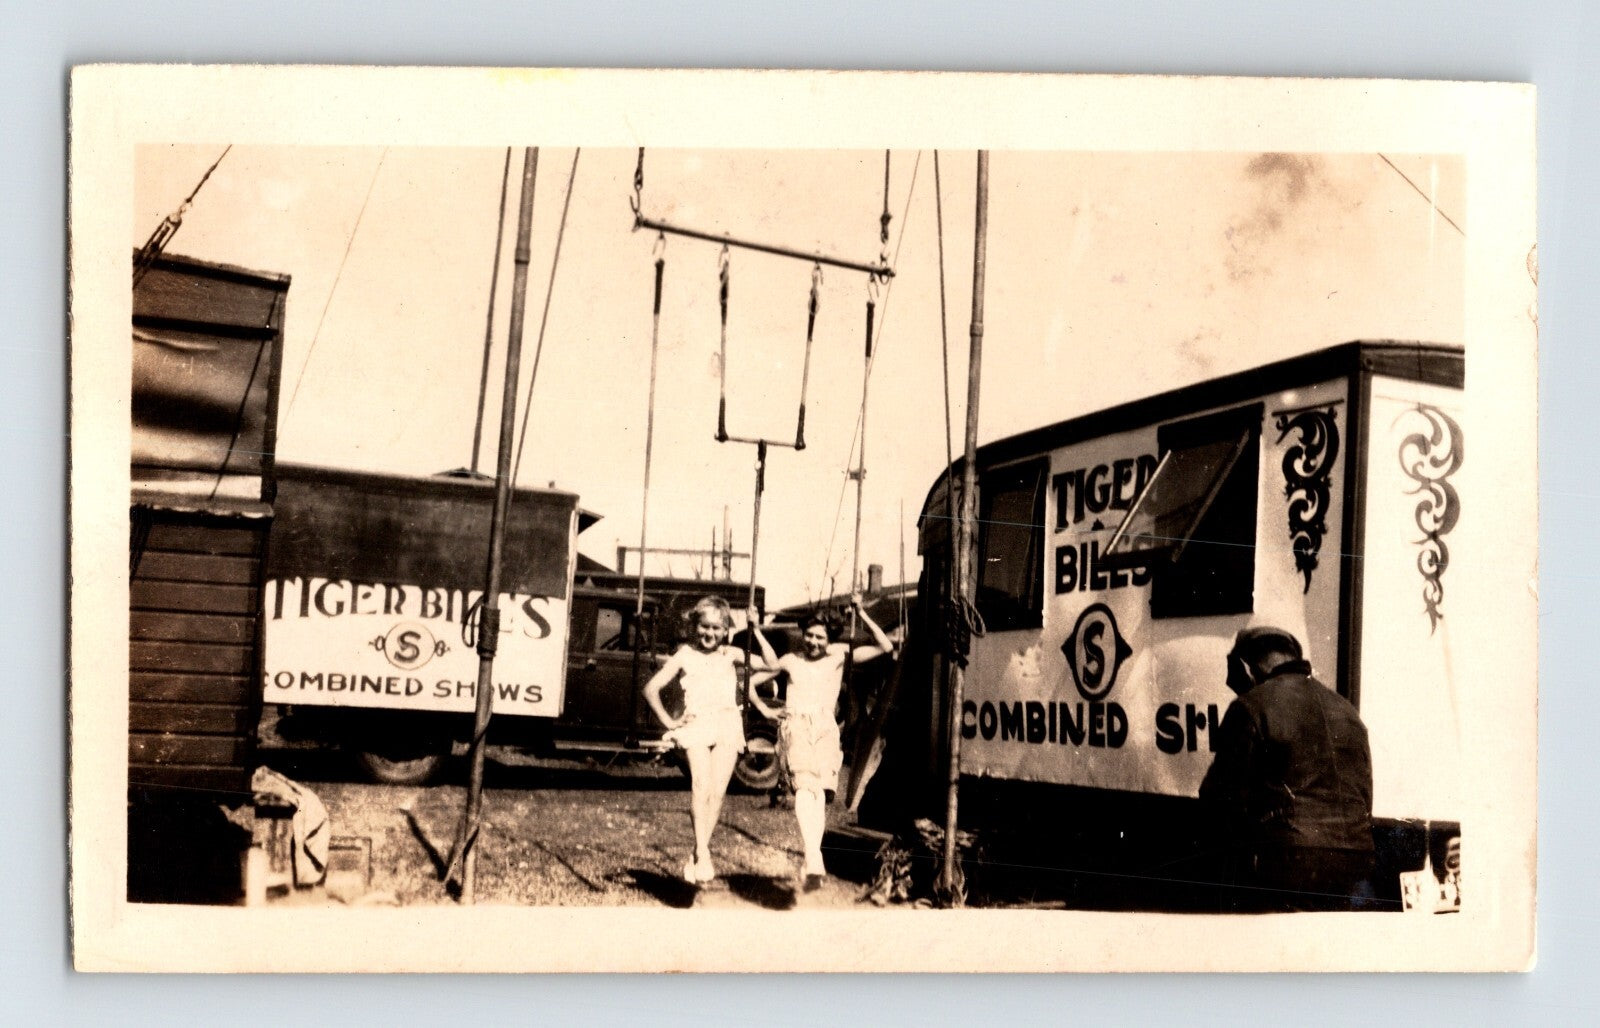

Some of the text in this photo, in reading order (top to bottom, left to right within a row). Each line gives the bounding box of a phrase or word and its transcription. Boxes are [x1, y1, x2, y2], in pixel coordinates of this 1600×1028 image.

[263, 578, 407, 620] TIGER
[394, 631, 421, 662] S
[264, 670, 543, 702] OMBINED SHWS
[961, 701, 1129, 749] COMBINED
